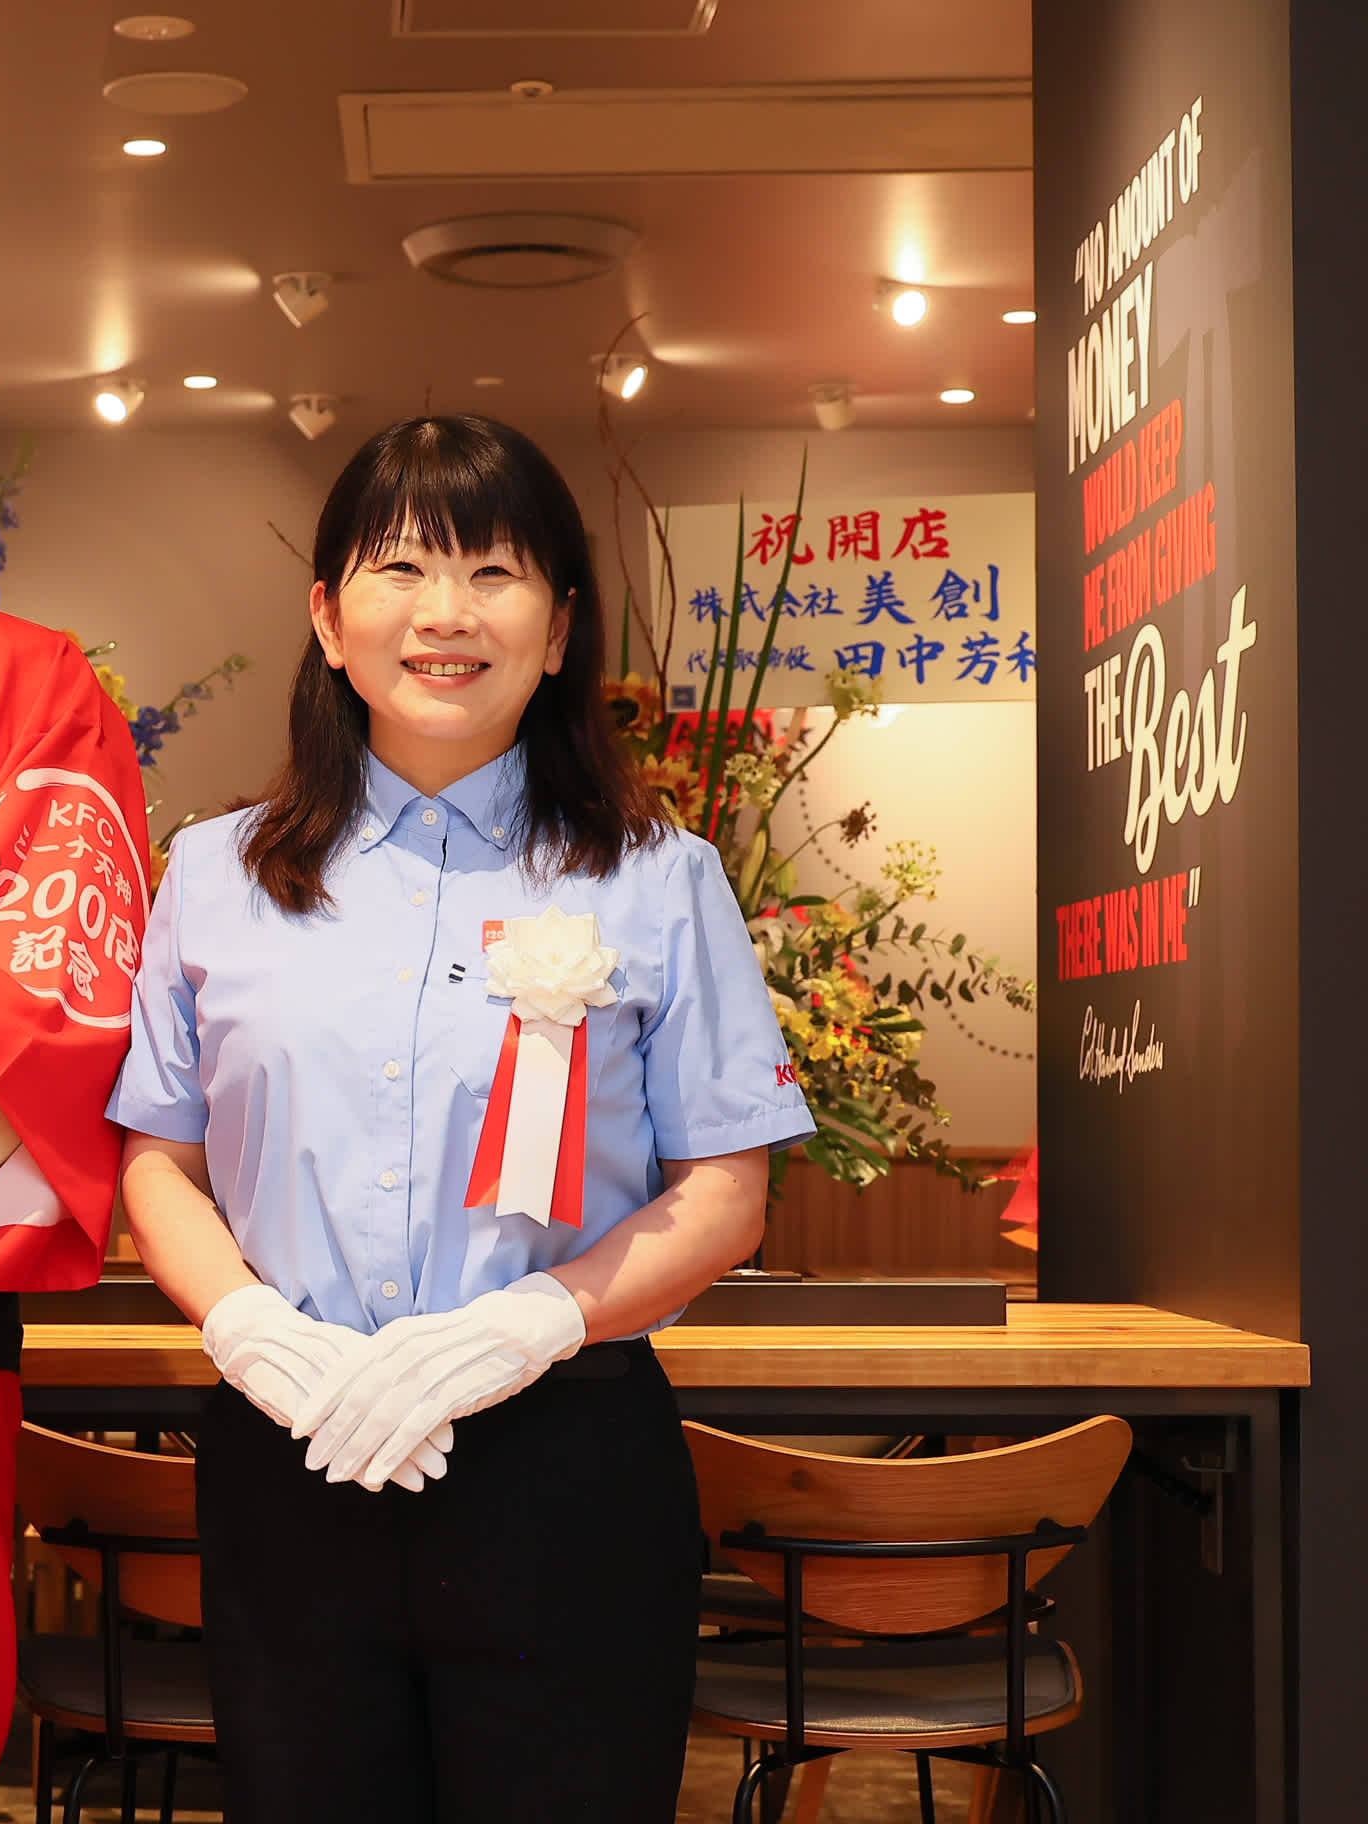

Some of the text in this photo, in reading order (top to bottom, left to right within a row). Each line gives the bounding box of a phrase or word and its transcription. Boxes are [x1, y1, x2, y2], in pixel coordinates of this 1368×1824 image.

[1107, 129, 1175, 291] AMOUNT
[1179, 95, 1203, 204] OF
[1068, 260, 1154, 475] MONEY
[745, 508, 951, 566] 祝開店
[1083, 398, 1183, 556] WOULD KEEP
[1084, 481, 1217, 653] ME FROM GIVING
[1084, 584, 1257, 874] THE Best
[47, 799, 115, 847] KFC
[1056, 895, 1103, 981] THERE
[1104, 885, 1140, 974] WAS
[1141, 879, 1160, 968] IN
